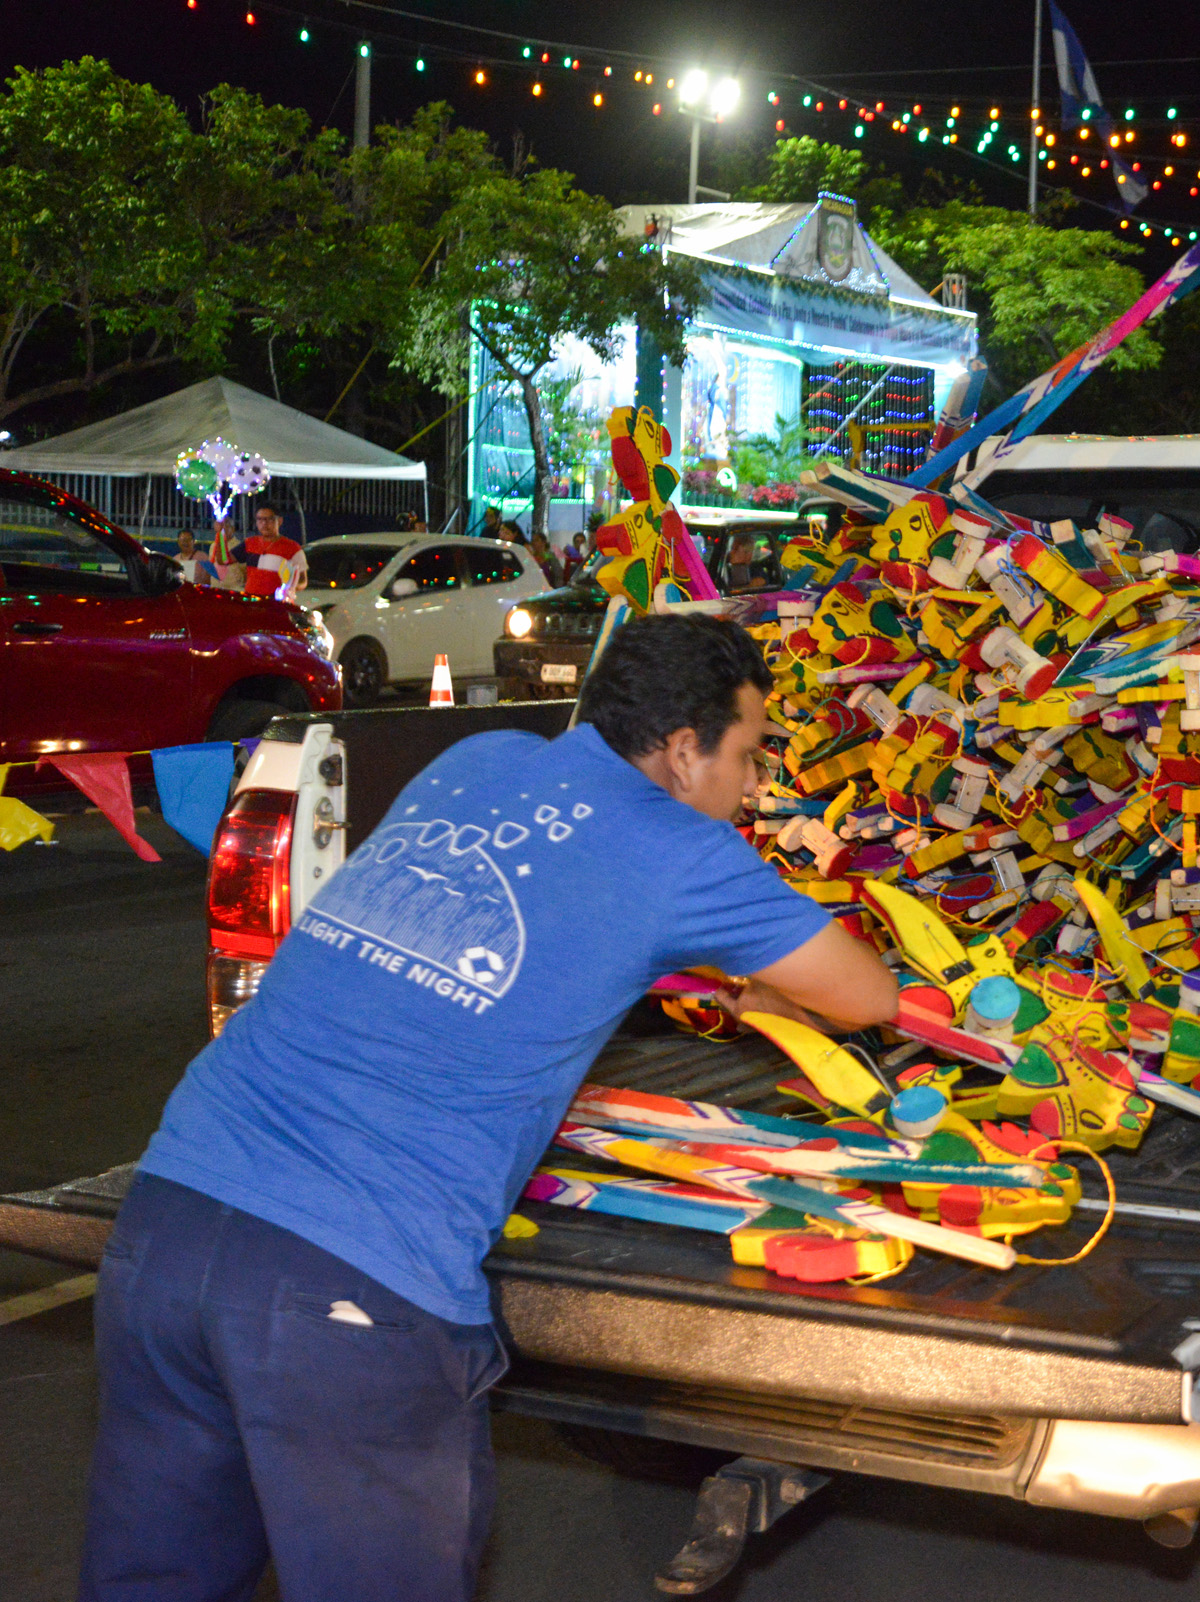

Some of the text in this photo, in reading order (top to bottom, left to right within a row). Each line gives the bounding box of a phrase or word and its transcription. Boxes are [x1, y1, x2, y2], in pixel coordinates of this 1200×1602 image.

[300, 916, 495, 1015] LIGHT THE NIGHT
